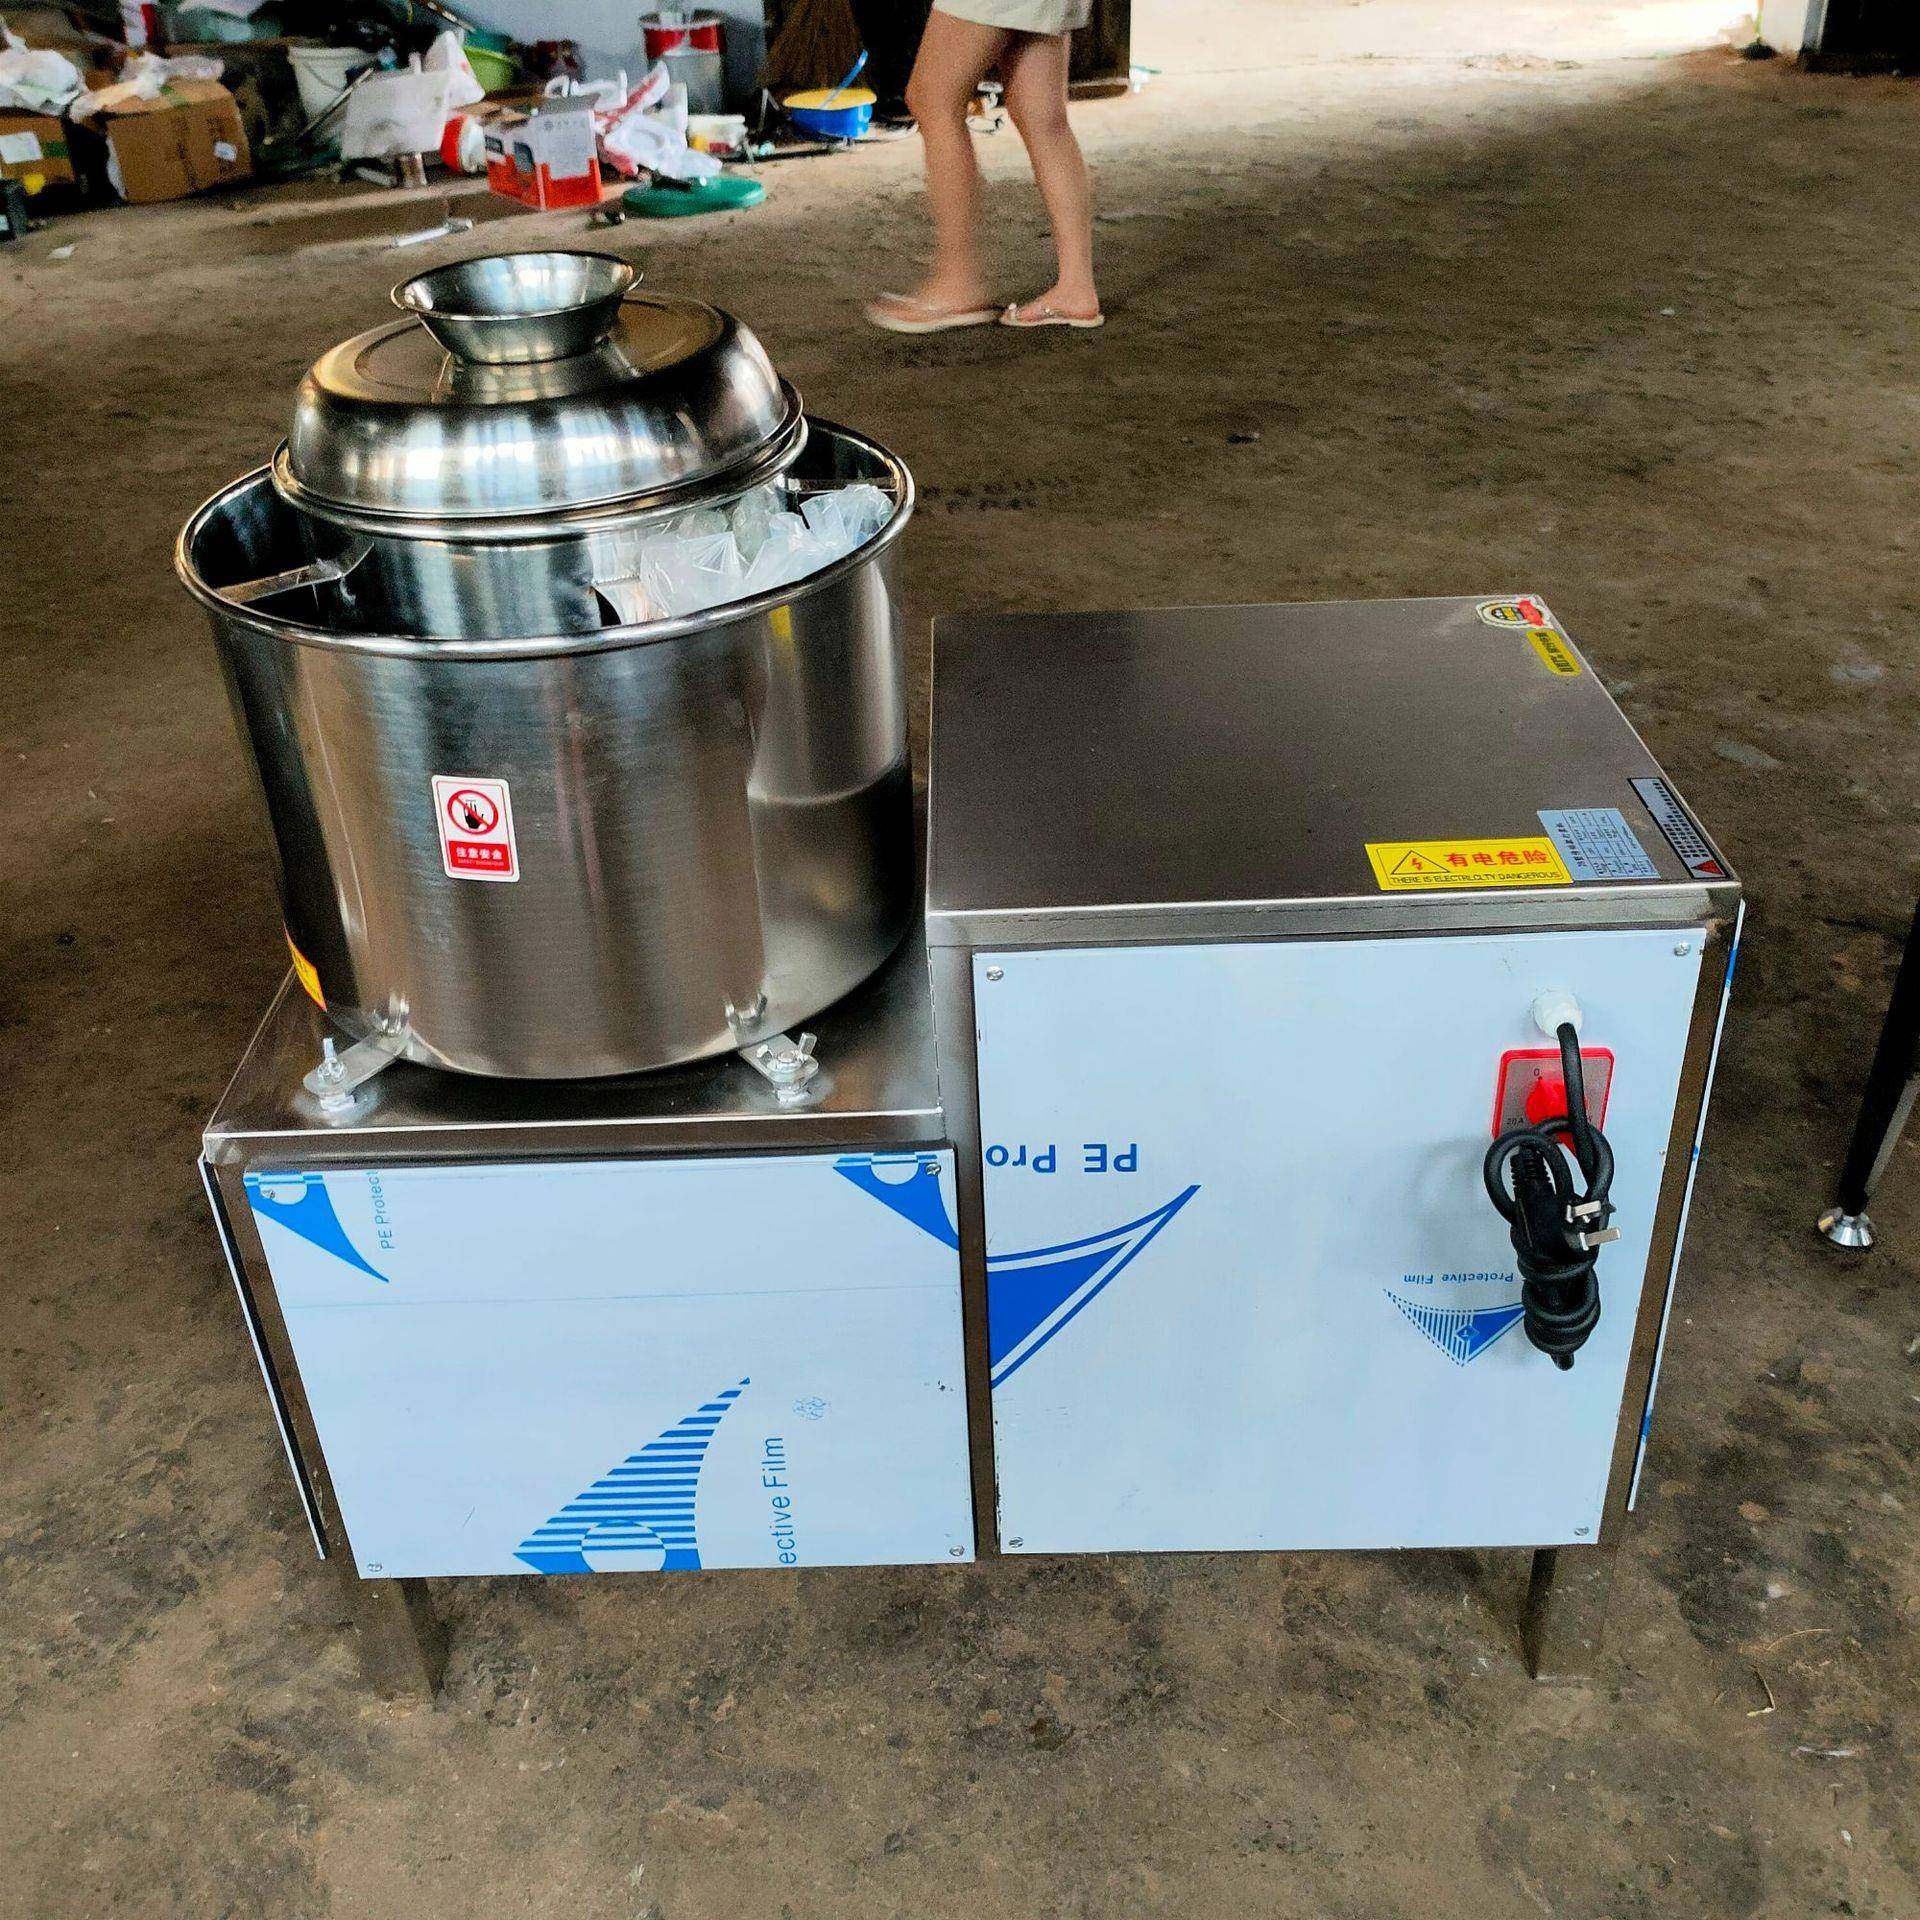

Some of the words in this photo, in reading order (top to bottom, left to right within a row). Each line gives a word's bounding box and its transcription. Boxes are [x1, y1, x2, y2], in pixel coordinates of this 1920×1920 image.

[1445, 849, 1550, 868] 有电危险
[1391, 875, 1420, 884] THERE
[1422, 875, 1432, 883] IS
[1498, 871, 1562, 881] DANGEROUS
[985, 1144, 1056, 1174] Pro
[1083, 1143, 1138, 1173] PE
[378, 1229, 395, 1249] PE
[1403, 1273, 1434, 1285] Film
[1441, 1272, 1514, 1283] Protective
[760, 1437, 788, 1488] Film
[769, 1496, 797, 1564] ective
